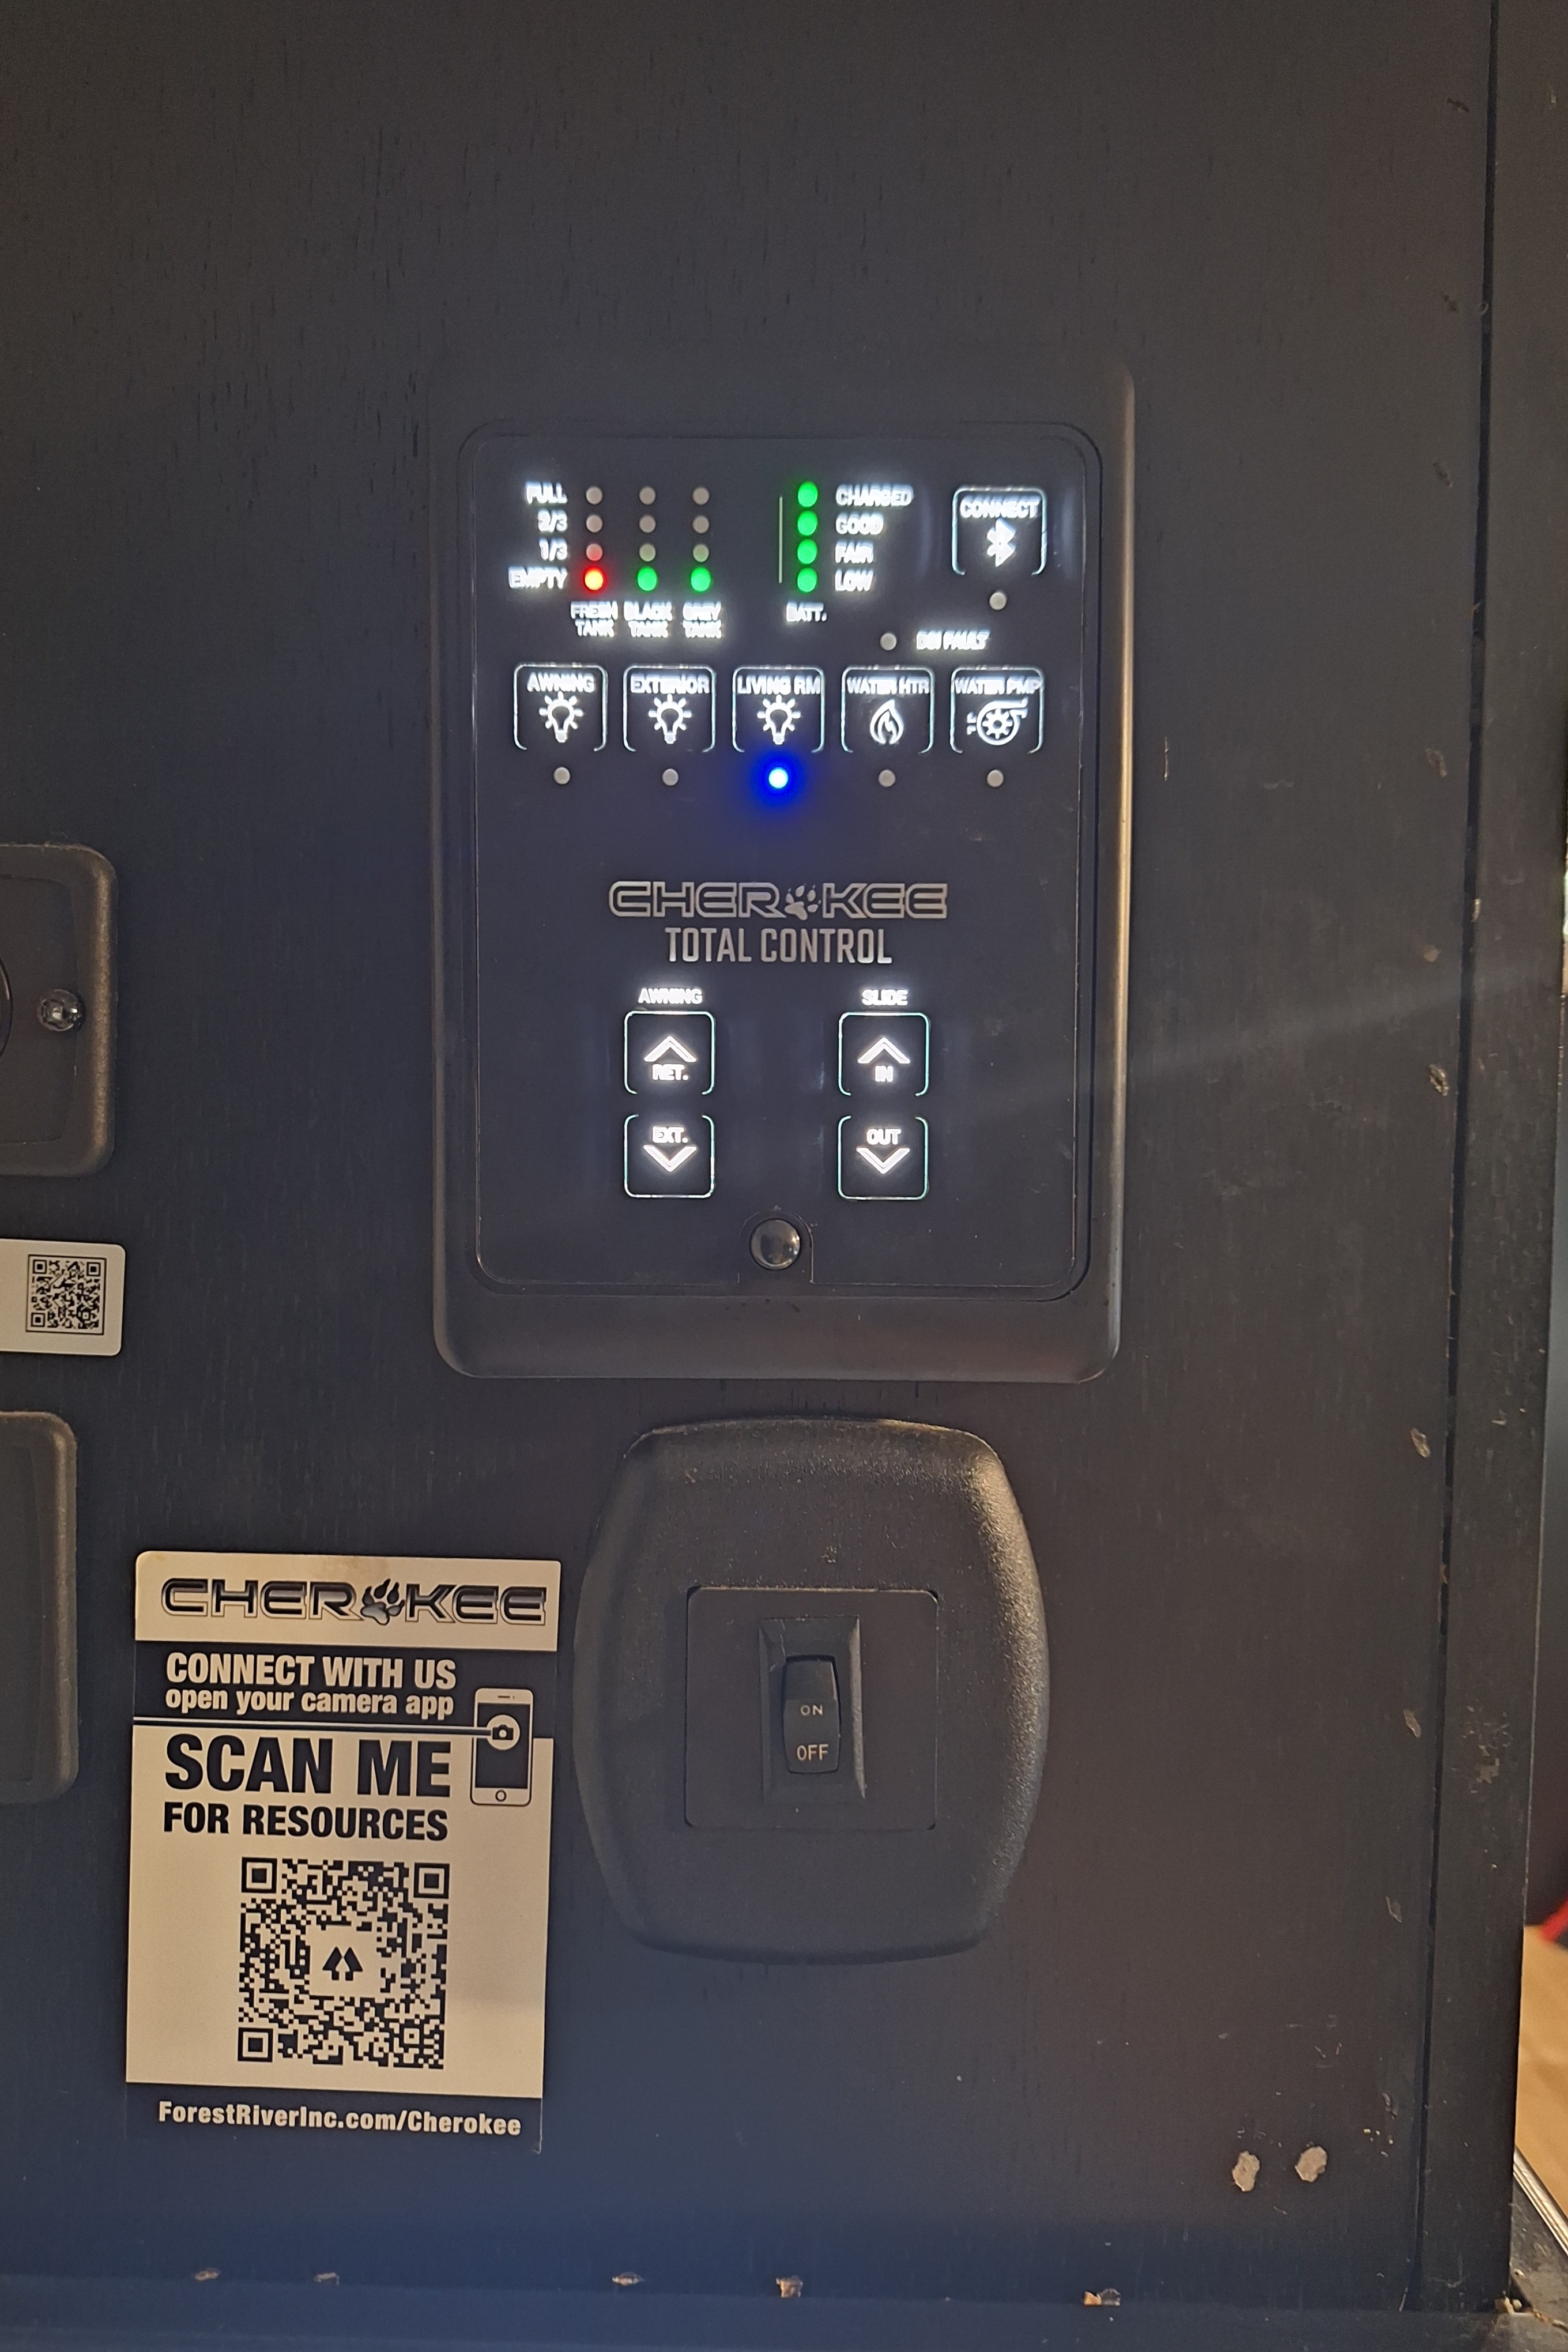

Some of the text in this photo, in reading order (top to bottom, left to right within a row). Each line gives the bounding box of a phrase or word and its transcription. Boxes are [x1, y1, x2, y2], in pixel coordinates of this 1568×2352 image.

[525, 482, 568, 504] FULL
[836, 484, 914, 506] CHARGED
[960, 496, 1041, 518] CONNECT
[537, 509, 568, 533] 2/3
[836, 512, 884, 534] GOOD
[538, 538, 568, 561] 1/3
[835, 541, 874, 563] FAIR
[508, 566, 568, 589] EMPTY
[835, 568, 874, 591] LOW
[571, 601, 618, 620] FRESH
[624, 601, 672, 621] BLACK
[786, 601, 827, 622] BATT.
[575, 619, 615, 636] TANK
[628, 620, 669, 638] TANK
[683, 620, 722, 638] TANK
[527, 672, 595, 692] AWNING
[630, 674, 710, 694] EXTERIOR
[737, 676, 821, 695] LIVING RM
[847, 677, 929, 695] WATER HTR
[955, 677, 1041, 695] WATER PMP
[665, 927, 892, 964] TOTAL CONTROL
[638, 988, 703, 1004] AWNING
[862, 989, 908, 1005] SLIDE
[652, 1064, 689, 1081] RET.
[874, 1066, 894, 1083] IN
[652, 1126, 688, 1144] EXT.
[866, 1128, 901, 1145] OUT
[166, 1652, 457, 1690] CONNECT WITH US
[165, 1688, 454, 1720] open your camera app
[800, 1705, 823, 1716] ON
[797, 1743, 829, 1761] OFF
[165, 1733, 451, 1797] SCAN ME
[163, 1801, 448, 1841] FOR RESOURCES
[158, 2101, 522, 2135] ForestRiverInc.com/Cherokee
